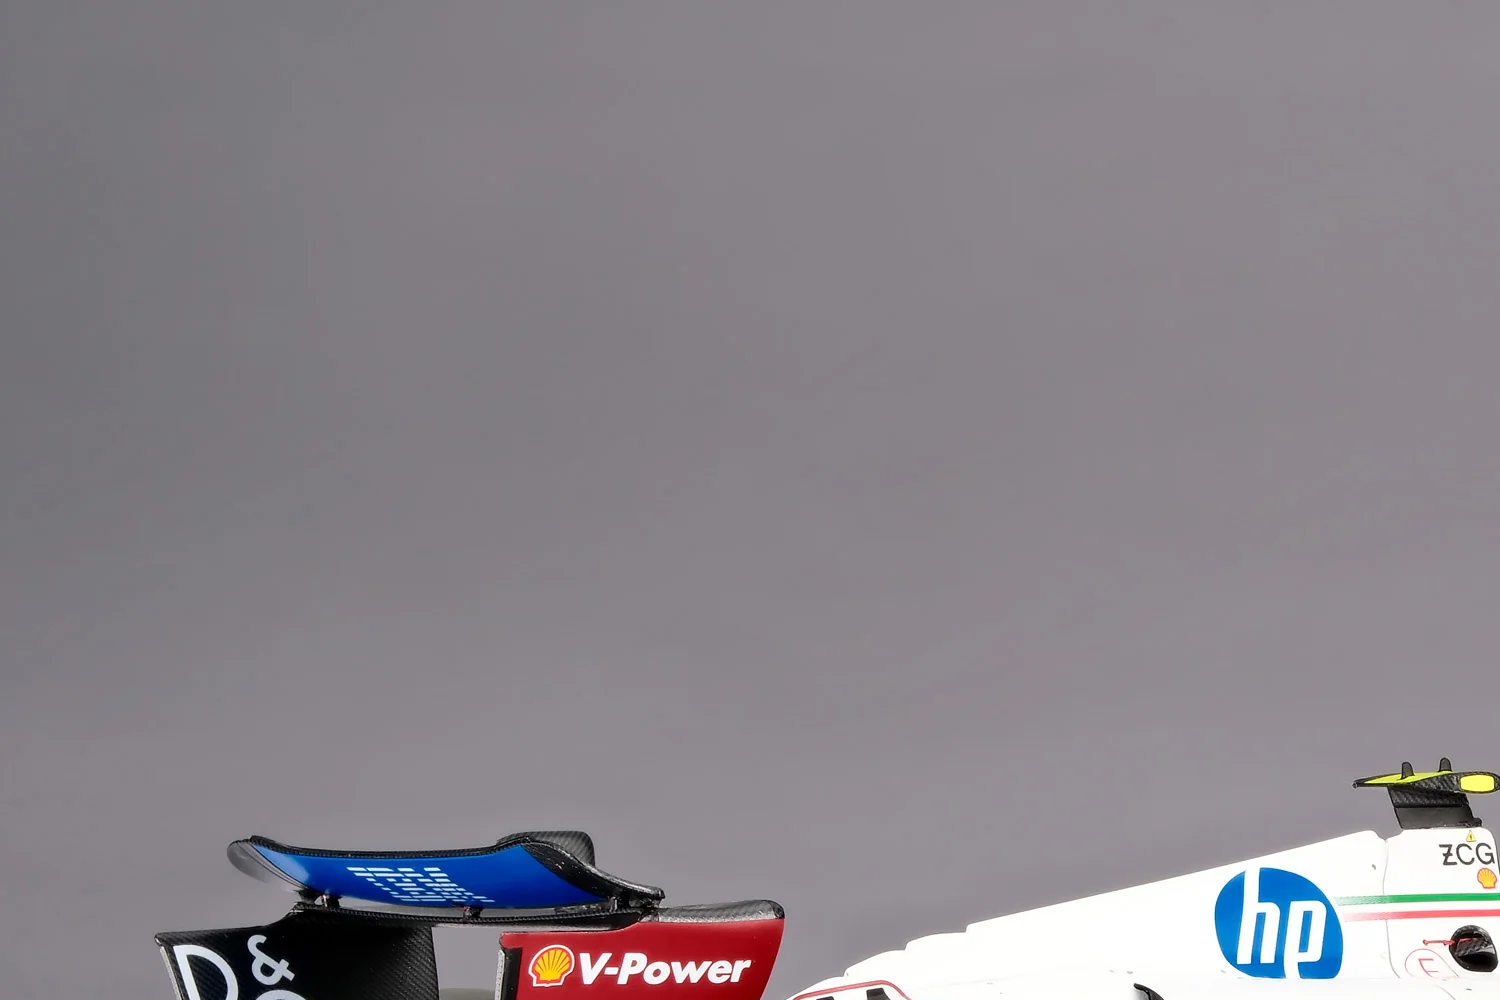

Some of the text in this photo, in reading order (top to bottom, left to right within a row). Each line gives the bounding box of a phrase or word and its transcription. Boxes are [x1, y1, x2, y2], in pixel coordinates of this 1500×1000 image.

[1439, 842, 1495, 866] ZCG
[1237, 867, 1327, 979] hp
[579, 952, 751, 985] V-Power
